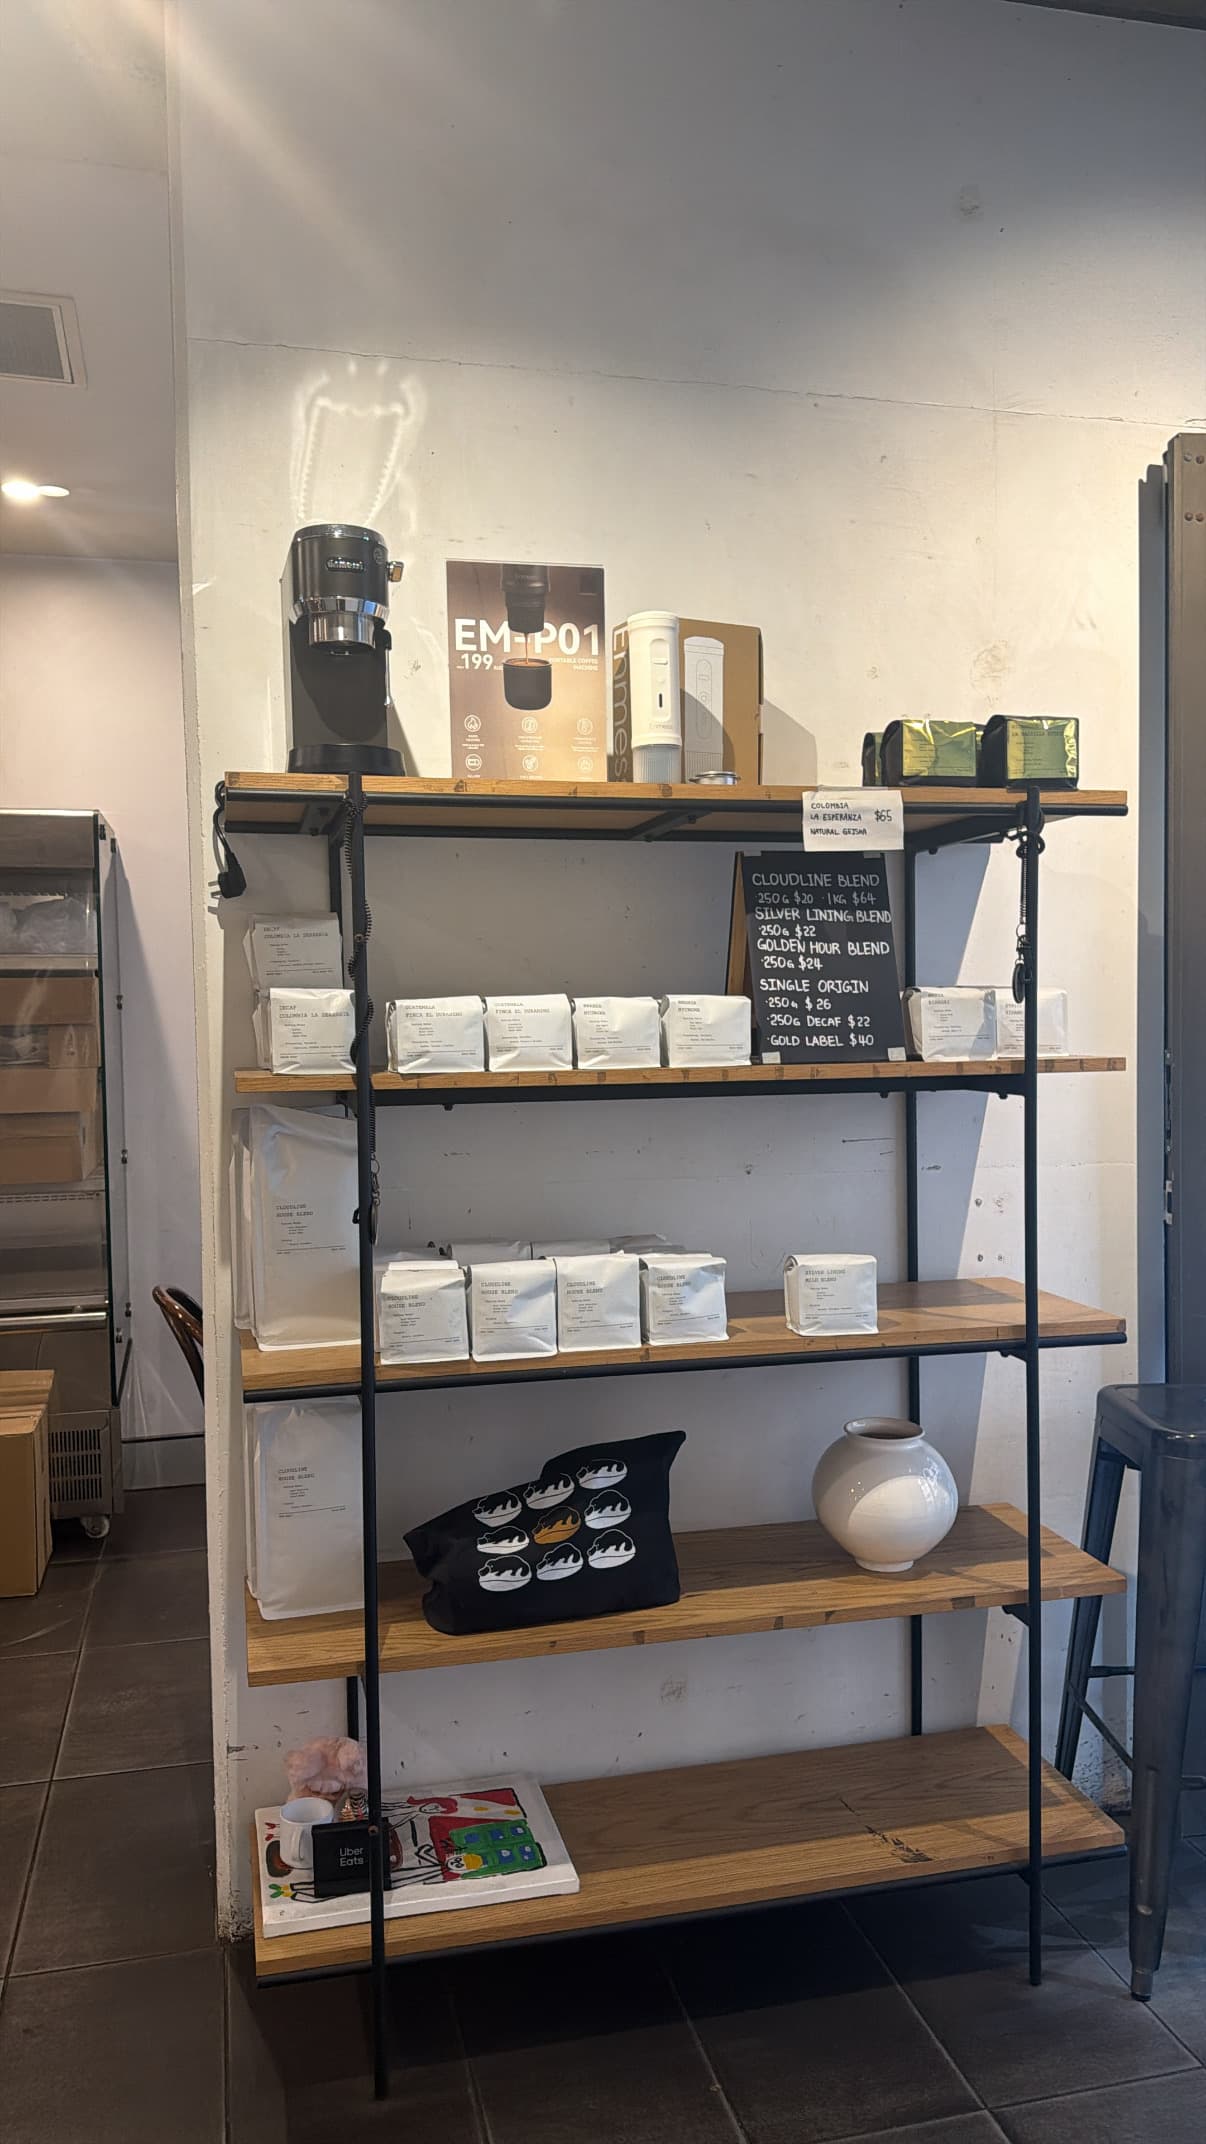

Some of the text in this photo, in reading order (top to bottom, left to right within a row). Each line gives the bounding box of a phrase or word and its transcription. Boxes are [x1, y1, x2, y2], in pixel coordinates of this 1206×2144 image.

[454, 618, 599, 656] EM-P01
[460, 653, 494, 670] 199
[613, 627, 629, 782] Enmes
[811, 802, 849, 810] COLOMBIA
[810, 809, 893, 823] LA ESPERANZA $65
[810, 828, 840, 836] NATURAL
[752, 873, 880, 888] CLOUDLINE BLEND
[757, 890, 877, 907] 250G $20 1KG $64
[755, 907, 892, 923] SILVER LINING BLEND
[760, 924, 816, 940] 250G $22
[757, 938, 890, 956] GOLDEN HOUR BLEND
[763, 955, 823, 971] 250G $24
[759, 979, 869, 994] SINGLE ORIGIN
[770, 1014, 871, 1030] 250G DECAF $22
[770, 1034, 875, 1048] GOLD LABEL $40
[340, 1847, 364, 1856] Uber
[340, 1857, 364, 1867] Eats
